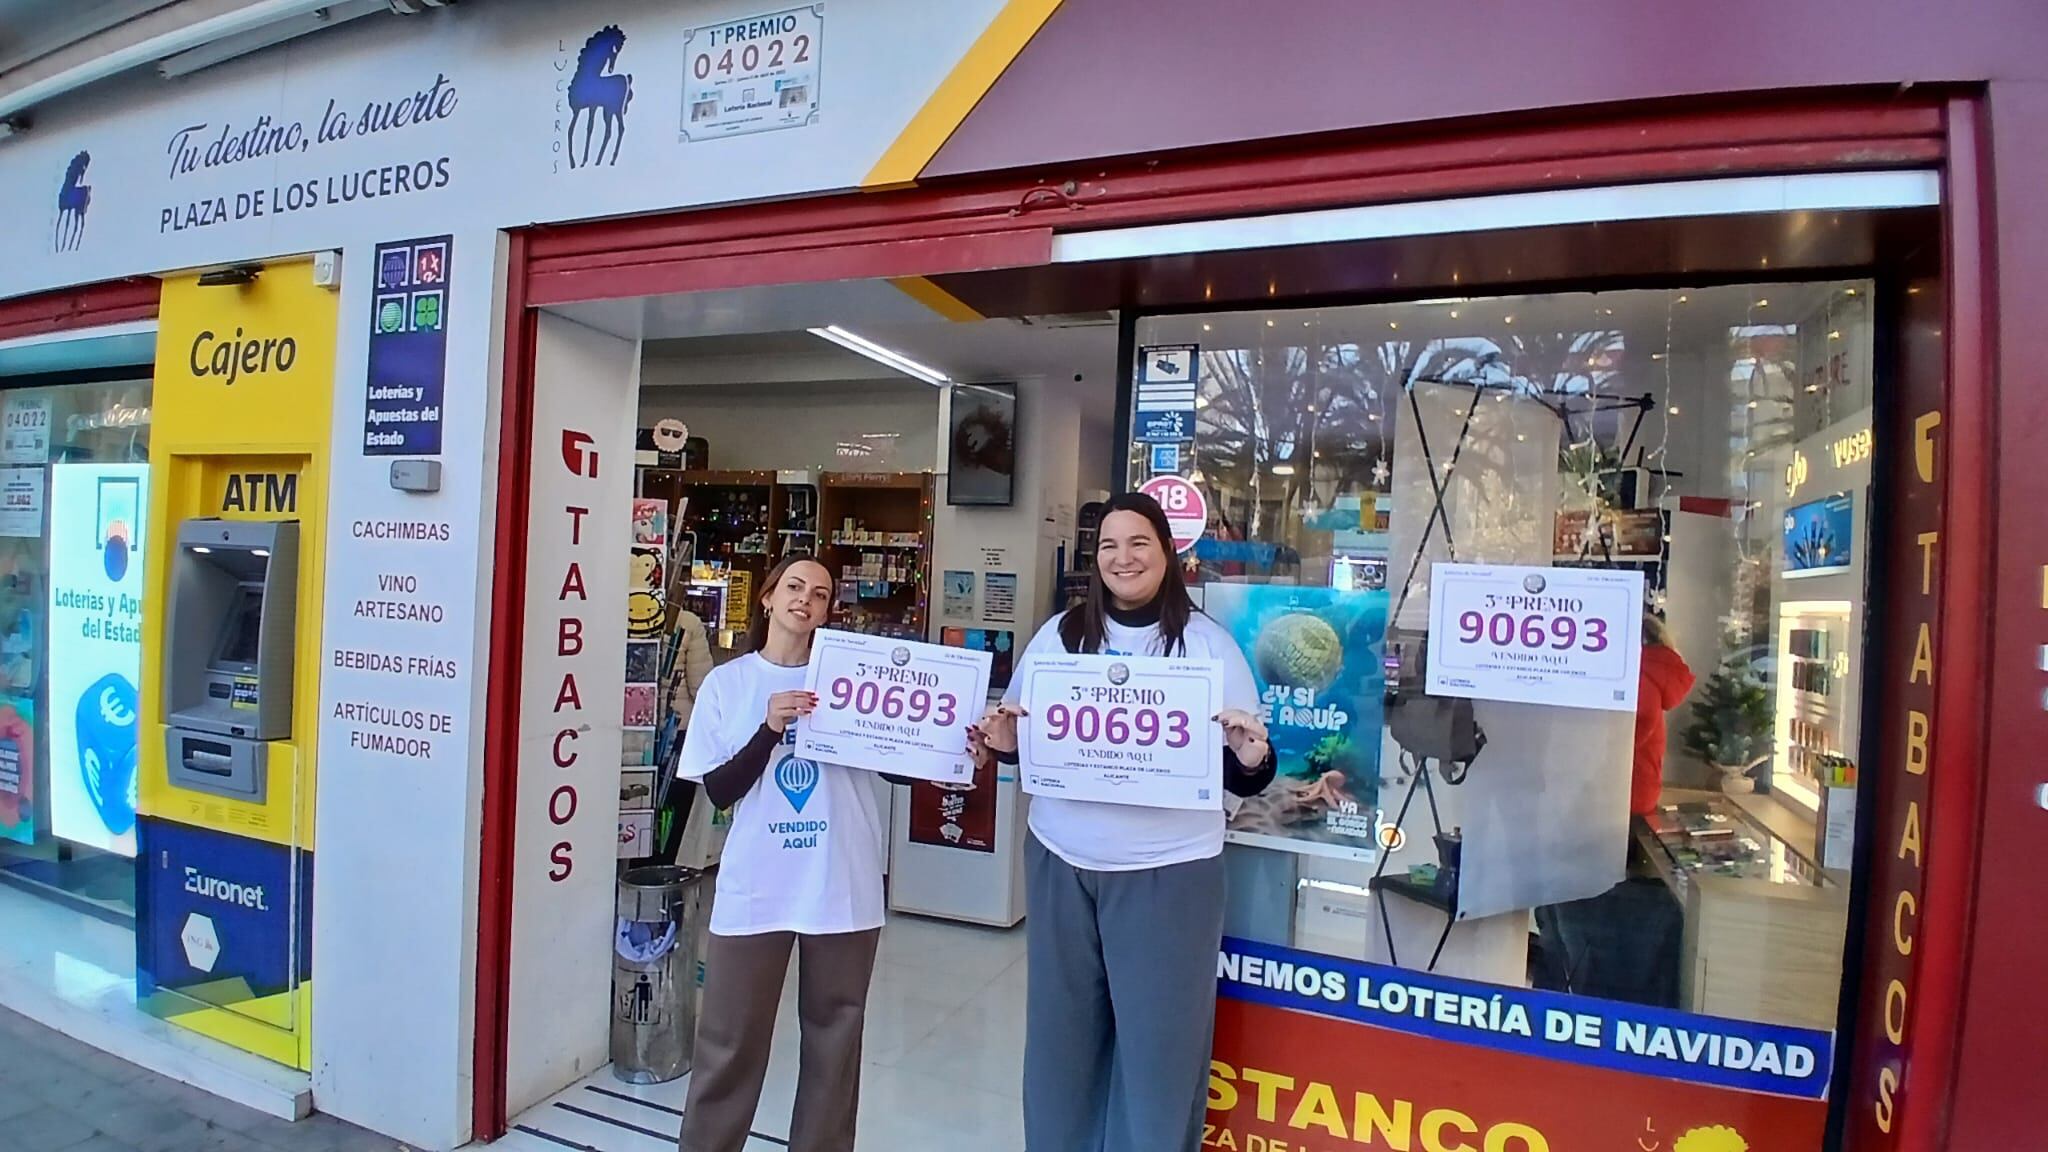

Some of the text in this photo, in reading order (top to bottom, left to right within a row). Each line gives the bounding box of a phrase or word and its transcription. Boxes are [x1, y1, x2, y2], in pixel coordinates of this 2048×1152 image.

[725, 15, 796, 44] PREMIO
[694, 35, 810, 80] 04022
[552, 39, 568, 175] LUCEROS
[168, 72, 459, 181] Tu destino, la suerte
[161, 157, 451, 233] PLAZA DE LOS LUCEROS
[190, 328, 297, 386] Cajero
[369, 384, 424, 403] Loterías y
[7, 411, 47, 428] 04022
[368, 406, 440, 427] Apuestas del
[367, 430, 405, 446] Estado
[222, 473, 297, 513] ATM
[352, 520, 451, 542] CACHIMBAS
[379, 574, 418, 593] VINO
[55, 587, 104, 611] Loterías
[107, 595, 116, 618] y
[354, 599, 444, 623] ARTESANO
[1506, 595, 1583, 614] PREMIO
[82, 617, 101, 639] del
[1459, 611, 1608, 653] 90693
[334, 650, 457, 679] BEBIDAS FRÍAS
[1491, 651, 1539, 663] VENDIDO
[874, 665, 939, 688] PREMIO
[549, 505, 590, 883] TABACOS
[829, 677, 957, 727] 90693
[1091, 686, 1166, 706] PREMIO
[1293, 687, 1315, 708] SI
[334, 701, 452, 734] ARTÍCULOS DE
[855, 719, 895, 733] VENDIDO
[1046, 703, 1191, 749] 90693
[1279, 703, 1348, 731] AQUÍ?
[350, 731, 431, 759] FUMADOR
[1078, 748, 1124, 760] VENDIDO
[1339, 800, 1358, 815] YA
[768, 820, 828, 834] VENDIDO
[1875, 531, 1938, 1134] TABACOS
[782, 833, 818, 849] AQUÍ
[1357, 976, 1532, 1038] LOTERÍA
[1545, 1010, 1601, 1048] DE
[1615, 1019, 1816, 1079] NAVIDAD
